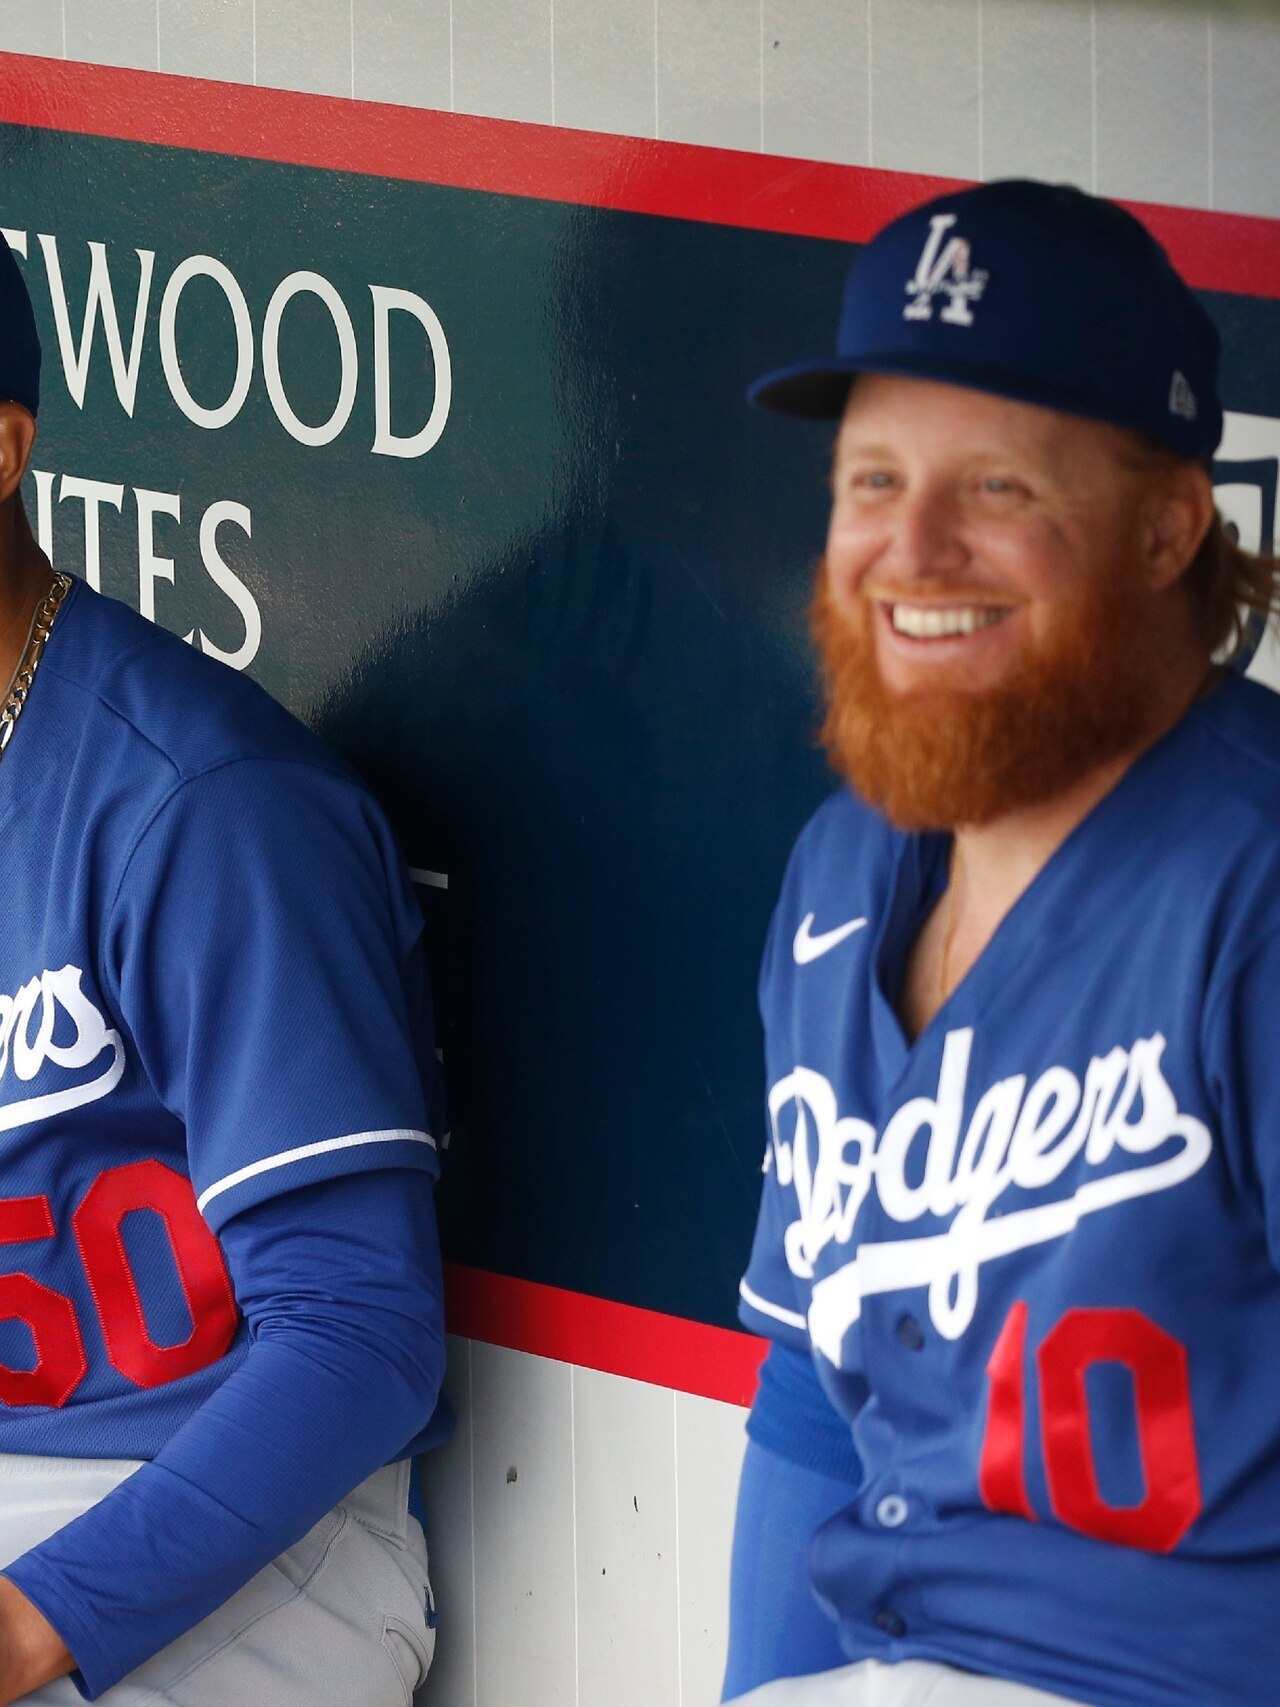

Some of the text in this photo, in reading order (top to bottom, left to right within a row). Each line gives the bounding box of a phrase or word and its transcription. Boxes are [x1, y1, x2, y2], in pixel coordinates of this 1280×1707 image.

[903, 213, 989, 327] LA
[31, 469, 263, 671] ITES
[766, 1026, 1213, 1370] Dodgers
[978, 1299, 1205, 1554] 10
